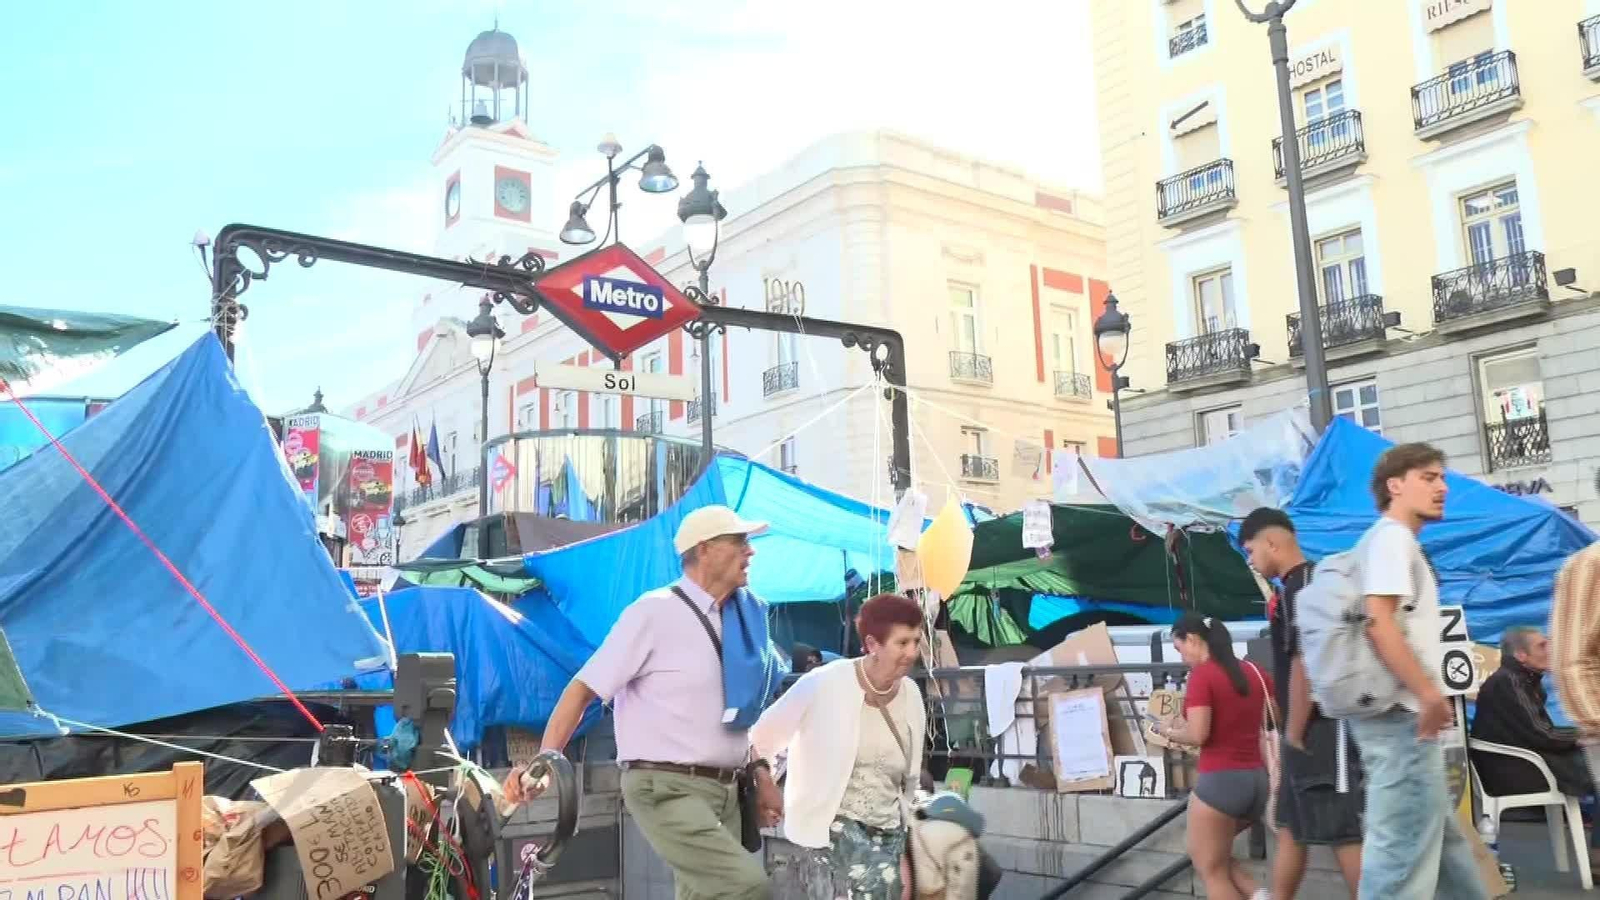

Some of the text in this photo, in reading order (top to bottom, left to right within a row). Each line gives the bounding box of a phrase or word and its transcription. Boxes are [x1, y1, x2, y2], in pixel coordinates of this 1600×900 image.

[590, 279, 659, 312] Metro
[604, 373, 635, 392] Sol
[353, 450, 393, 460] MADRID
